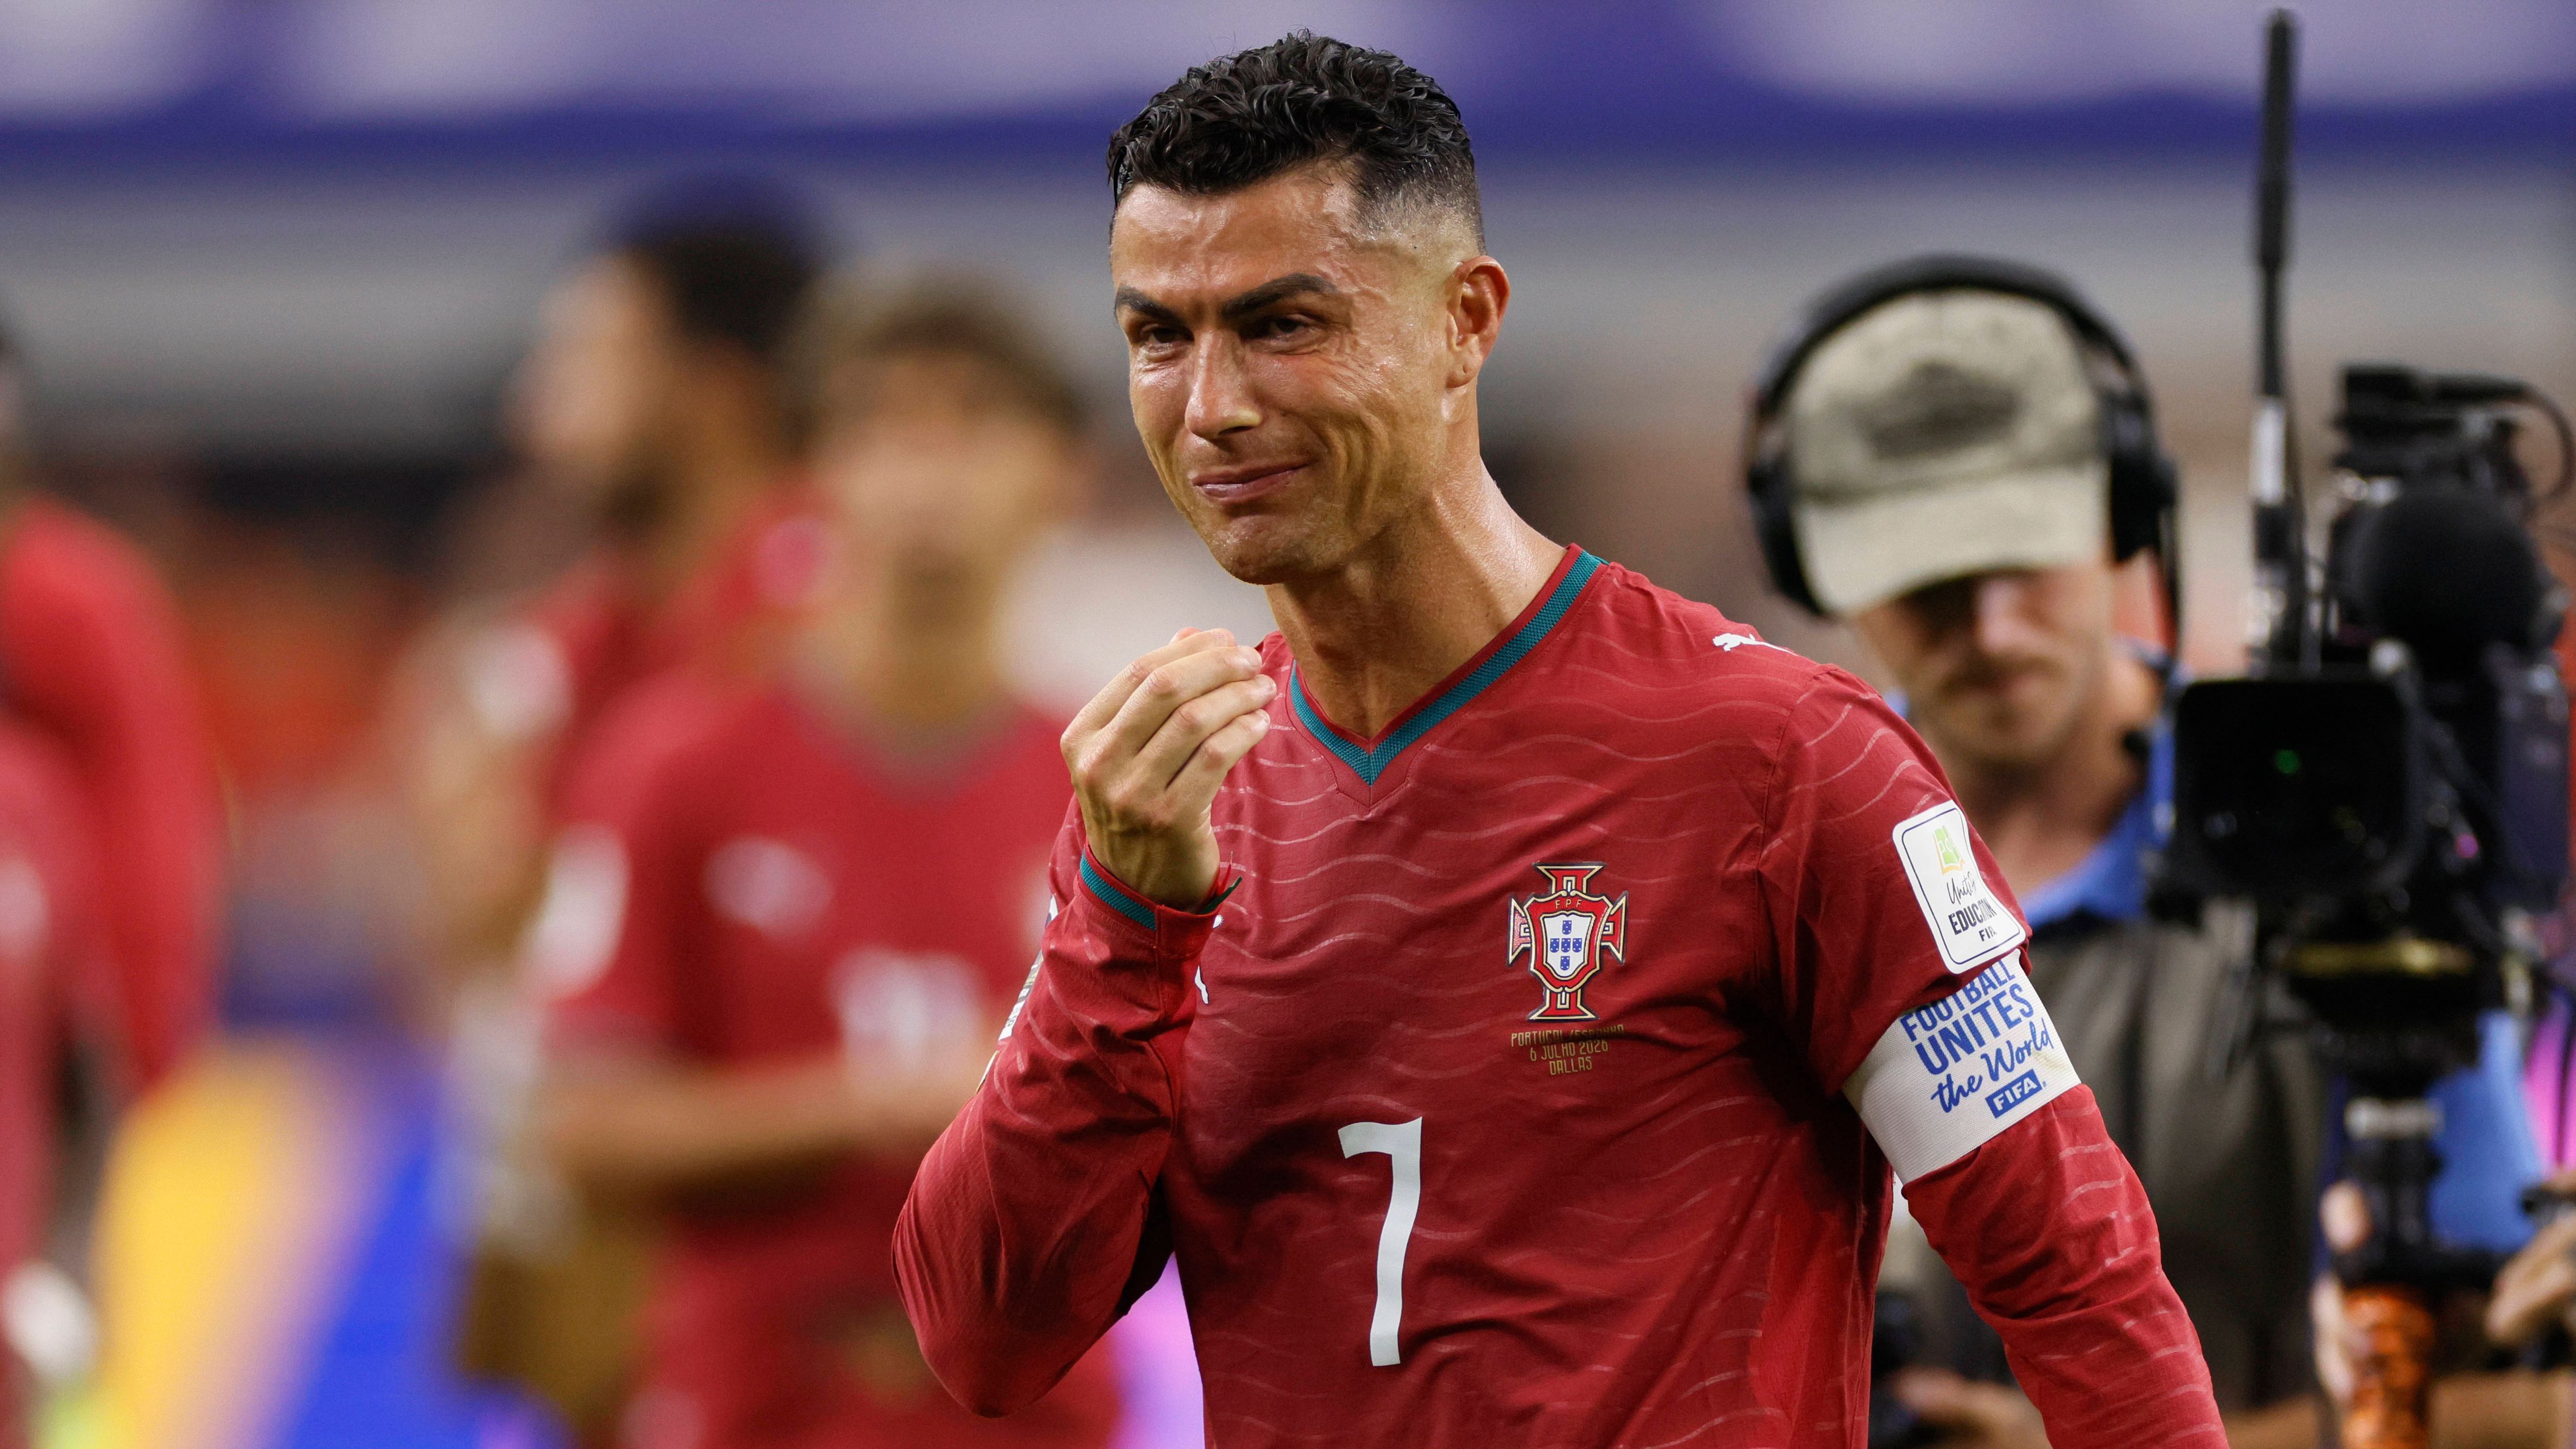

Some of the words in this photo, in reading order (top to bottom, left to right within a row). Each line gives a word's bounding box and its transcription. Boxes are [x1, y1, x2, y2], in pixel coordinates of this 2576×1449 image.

[1530, 1047, 1537, 1061] 6
[1541, 1042, 1576, 1060] JULHO
[1579, 1039, 1609, 1055] 2026
[1914, 983, 2034, 1075] UNITES
[1549, 1056, 1593, 1075] DALLAS
[1930, 1073, 1983, 1113] the
[1980, 1017, 2054, 1081] World
[1992, 1075, 2039, 1111] FIFA
[1337, 1116, 1422, 1367] 7
